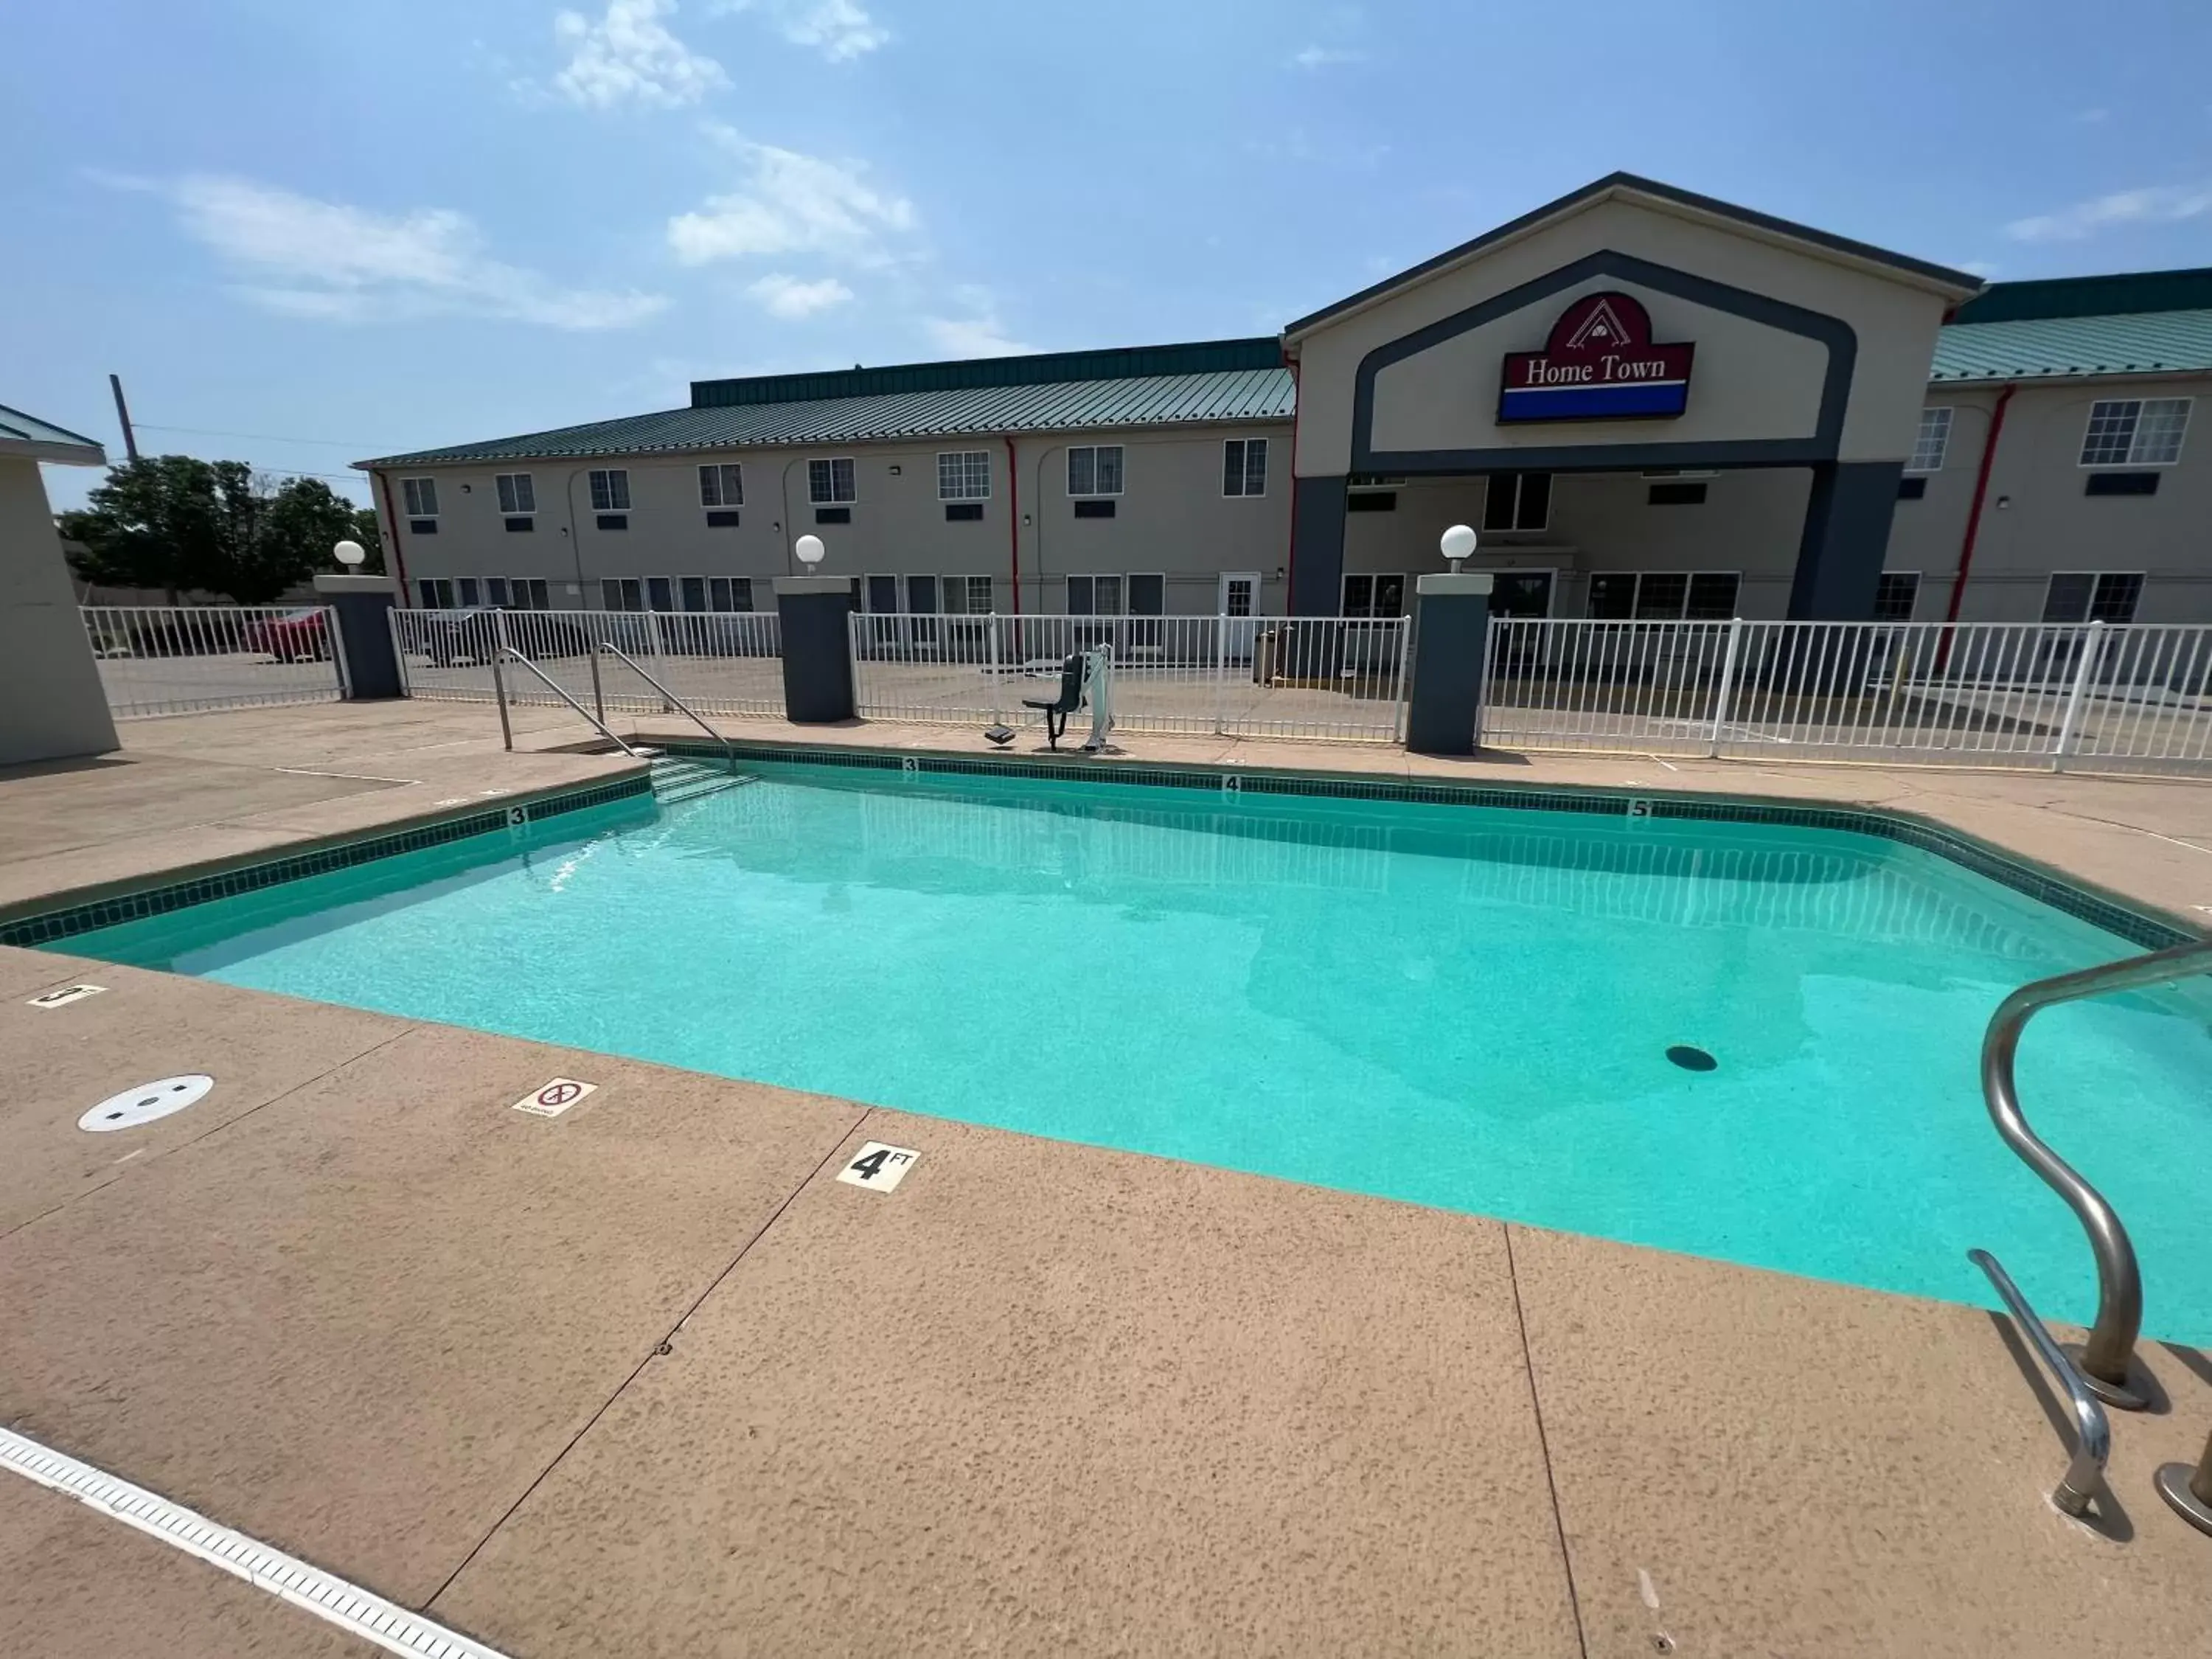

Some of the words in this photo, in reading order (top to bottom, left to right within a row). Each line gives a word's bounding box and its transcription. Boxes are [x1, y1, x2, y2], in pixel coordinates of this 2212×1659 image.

[1525, 358, 1593, 384] Home
[1601, 355, 1666, 380] Town
[905, 758, 917, 772] 3
[1226, 776, 1239, 791] 4
[511, 807, 526, 825] 3
[1632, 800, 1648, 816] 5
[849, 1149, 891, 1180] 4
[888, 1152, 914, 1166] FT
